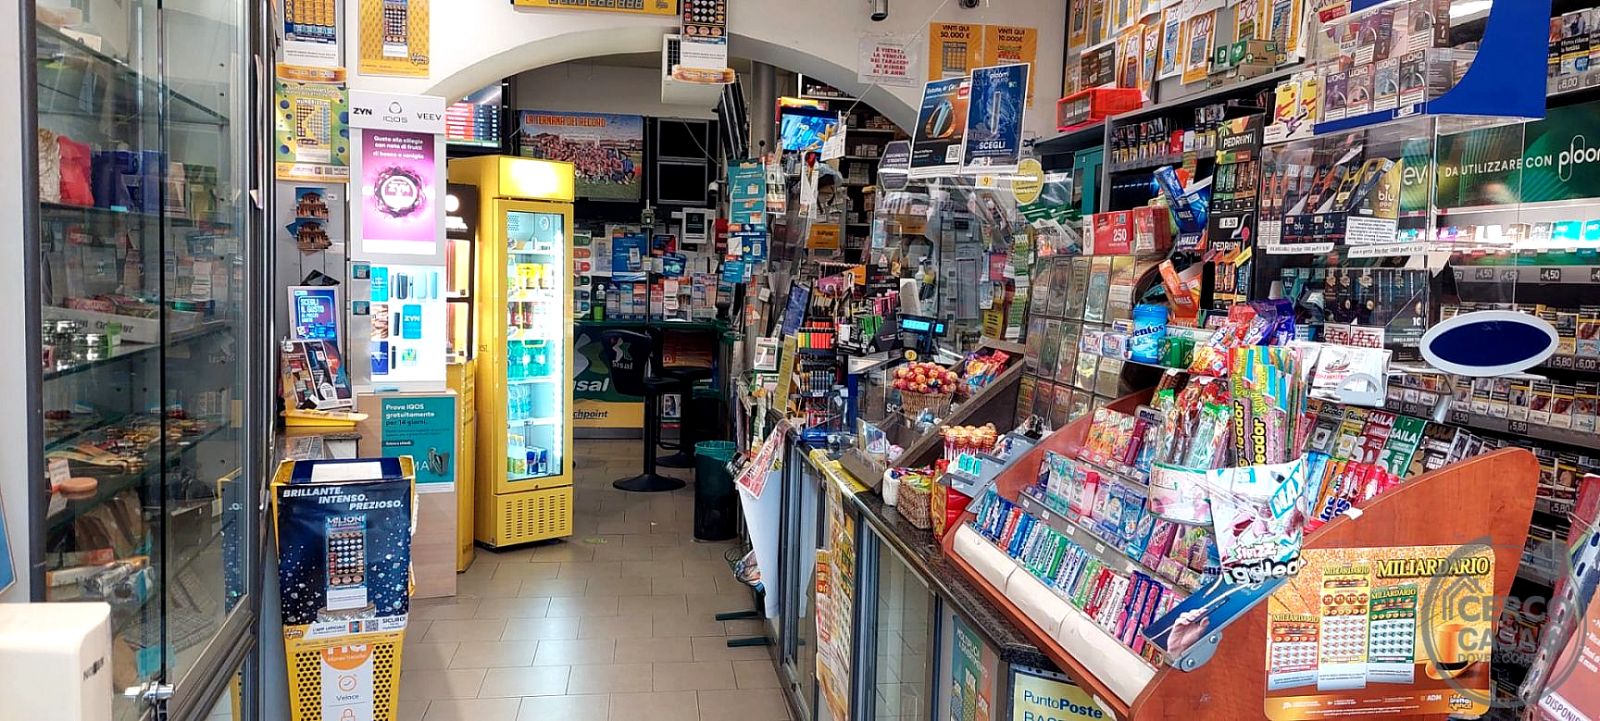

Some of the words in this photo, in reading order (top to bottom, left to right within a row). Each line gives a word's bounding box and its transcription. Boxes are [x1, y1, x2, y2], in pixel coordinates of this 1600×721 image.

[353, 107, 373, 116] ZYN
[417, 112, 442, 121] VEEV
[383, 115, 408, 123] IQOS
[979, 141, 1006, 150] SCEGLI
[1558, 134, 1600, 182] ploo
[1445, 166, 1458, 178] DA
[1461, 157, 1523, 176] UTILIZZARE
[1525, 154, 1553, 169] CON
[1378, 192, 1395, 202] blu
[1323, 217, 1335, 229] blu
[1113, 228, 1127, 242] 250
[1540, 268, 1561, 280] €4,50
[385, 403, 405, 411] Prova
[406, 403, 425, 411] IQOS
[385, 411, 436, 420] gratuitamente
[1369, 411, 1394, 427] SAILA
[1391, 428, 1417, 444] SAILA
[283, 487, 344, 498] BRILLANTE.
[318, 494, 369, 505] INTENSO.
[349, 499, 405, 511] PREZIOSO.
[1376, 556, 1490, 578] MILIARDARIO
[1370, 588, 1417, 600] MILIARDARIO
[1024, 689, 1103, 720] PuntoPoste
